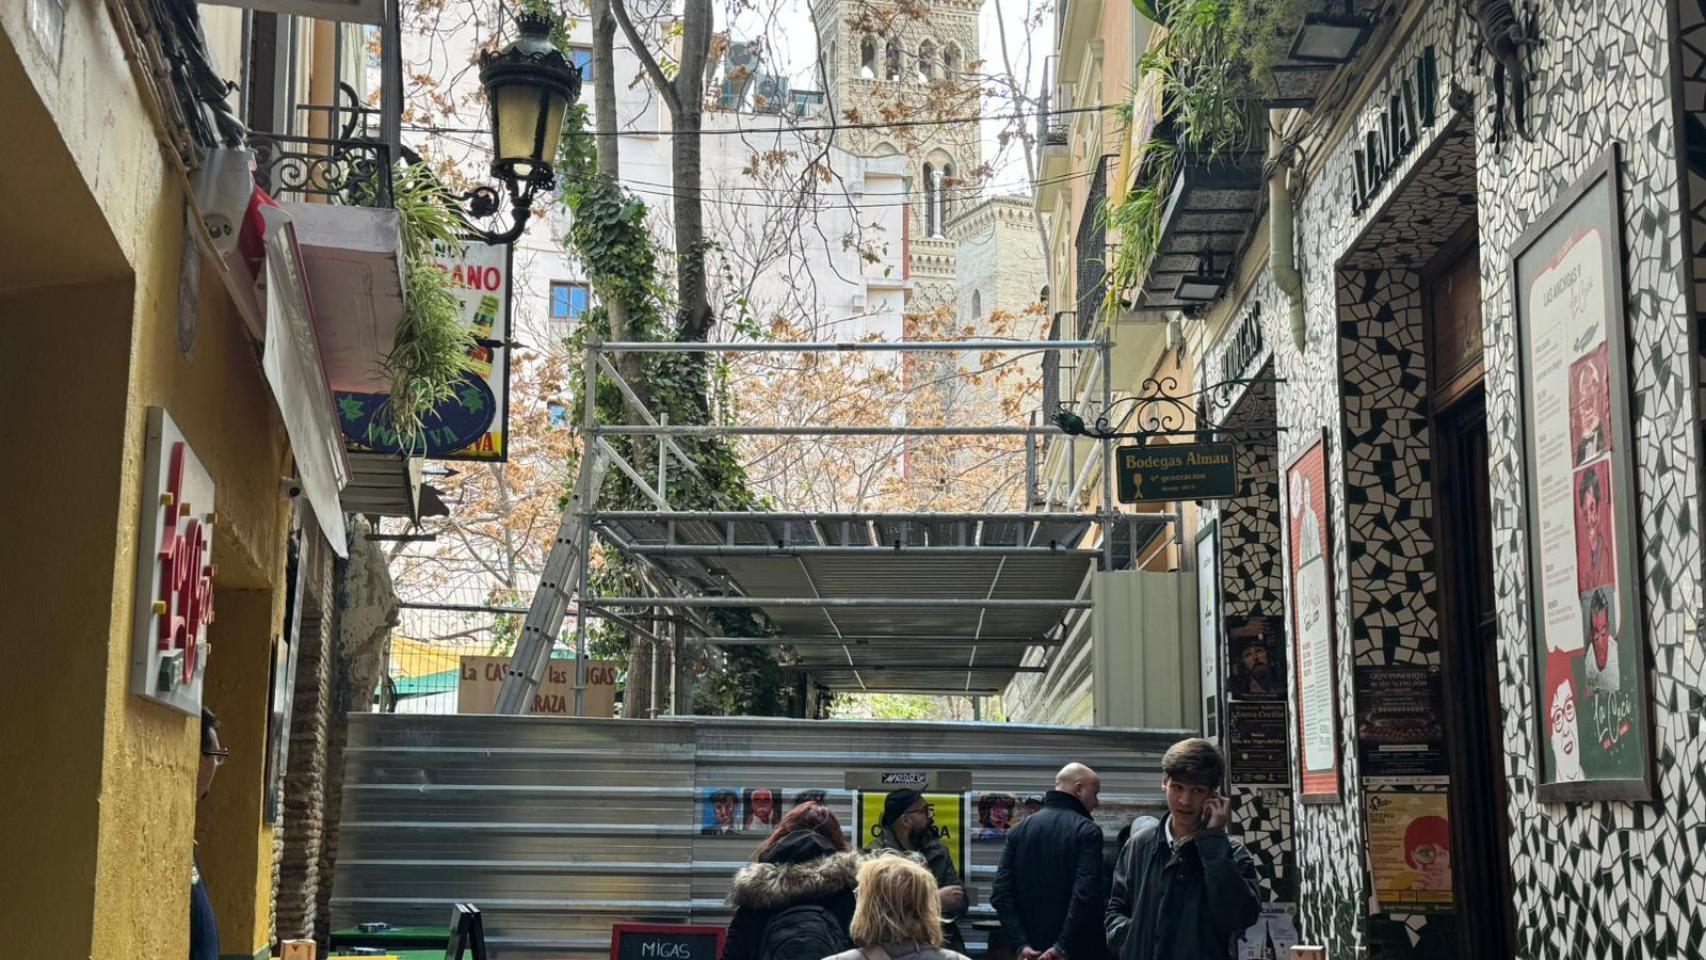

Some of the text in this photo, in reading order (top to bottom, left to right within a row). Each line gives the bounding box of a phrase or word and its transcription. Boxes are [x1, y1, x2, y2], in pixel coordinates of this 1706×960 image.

[1126, 451, 1229, 470] Bodegas Almau
[462, 663, 477, 681] La
[549, 666, 567, 684] las
